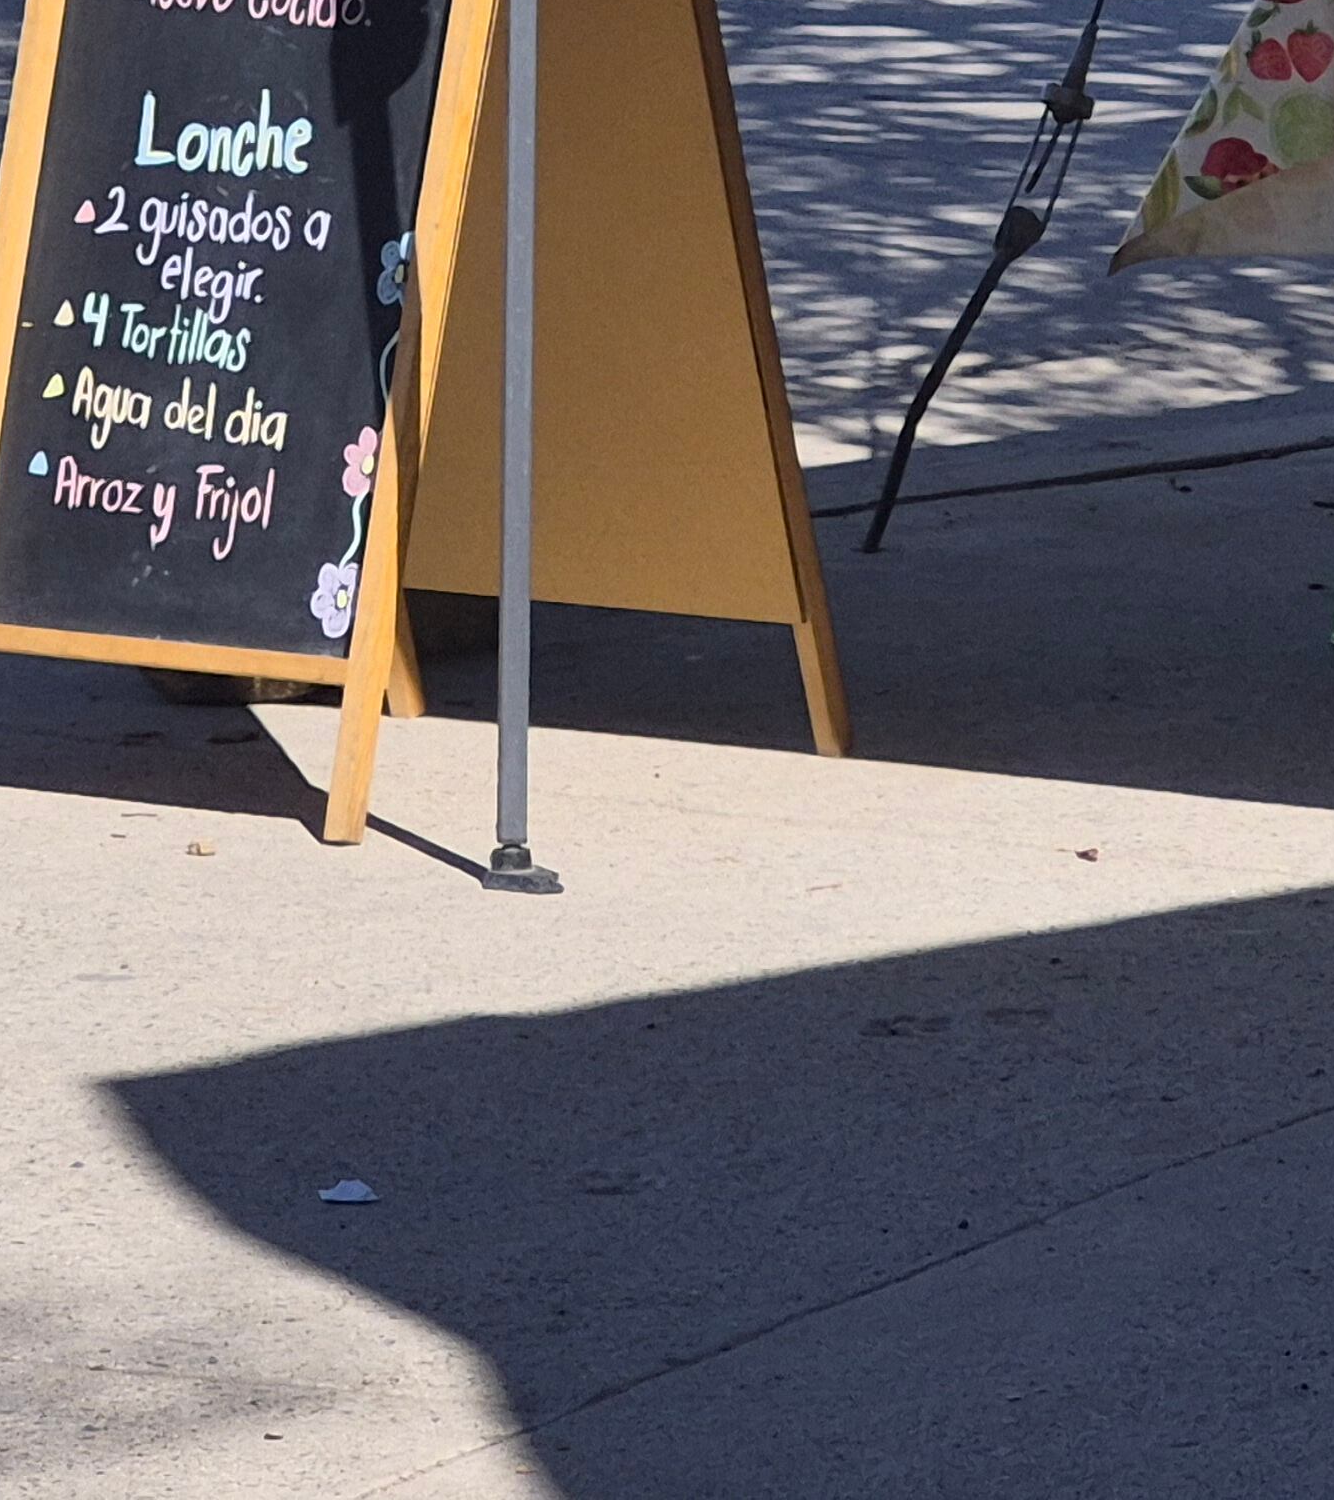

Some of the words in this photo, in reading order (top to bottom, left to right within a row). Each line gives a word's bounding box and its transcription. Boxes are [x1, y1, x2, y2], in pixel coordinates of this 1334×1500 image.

[134, 88, 313, 177] Lonche
[94, 186, 129, 235] 2
[135, 188, 291, 266] guisados
[303, 209, 332, 251] a
[83, 291, 110, 347] 4
[120, 303, 251, 373] Tortillas
[71, 365, 152, 450] Agua
[164, 376, 216, 441] del
[224, 387, 289, 451] dia
[53, 456, 144, 515] Arroz
[150, 483, 176, 544] y
[195, 464, 276, 561] Frijol
